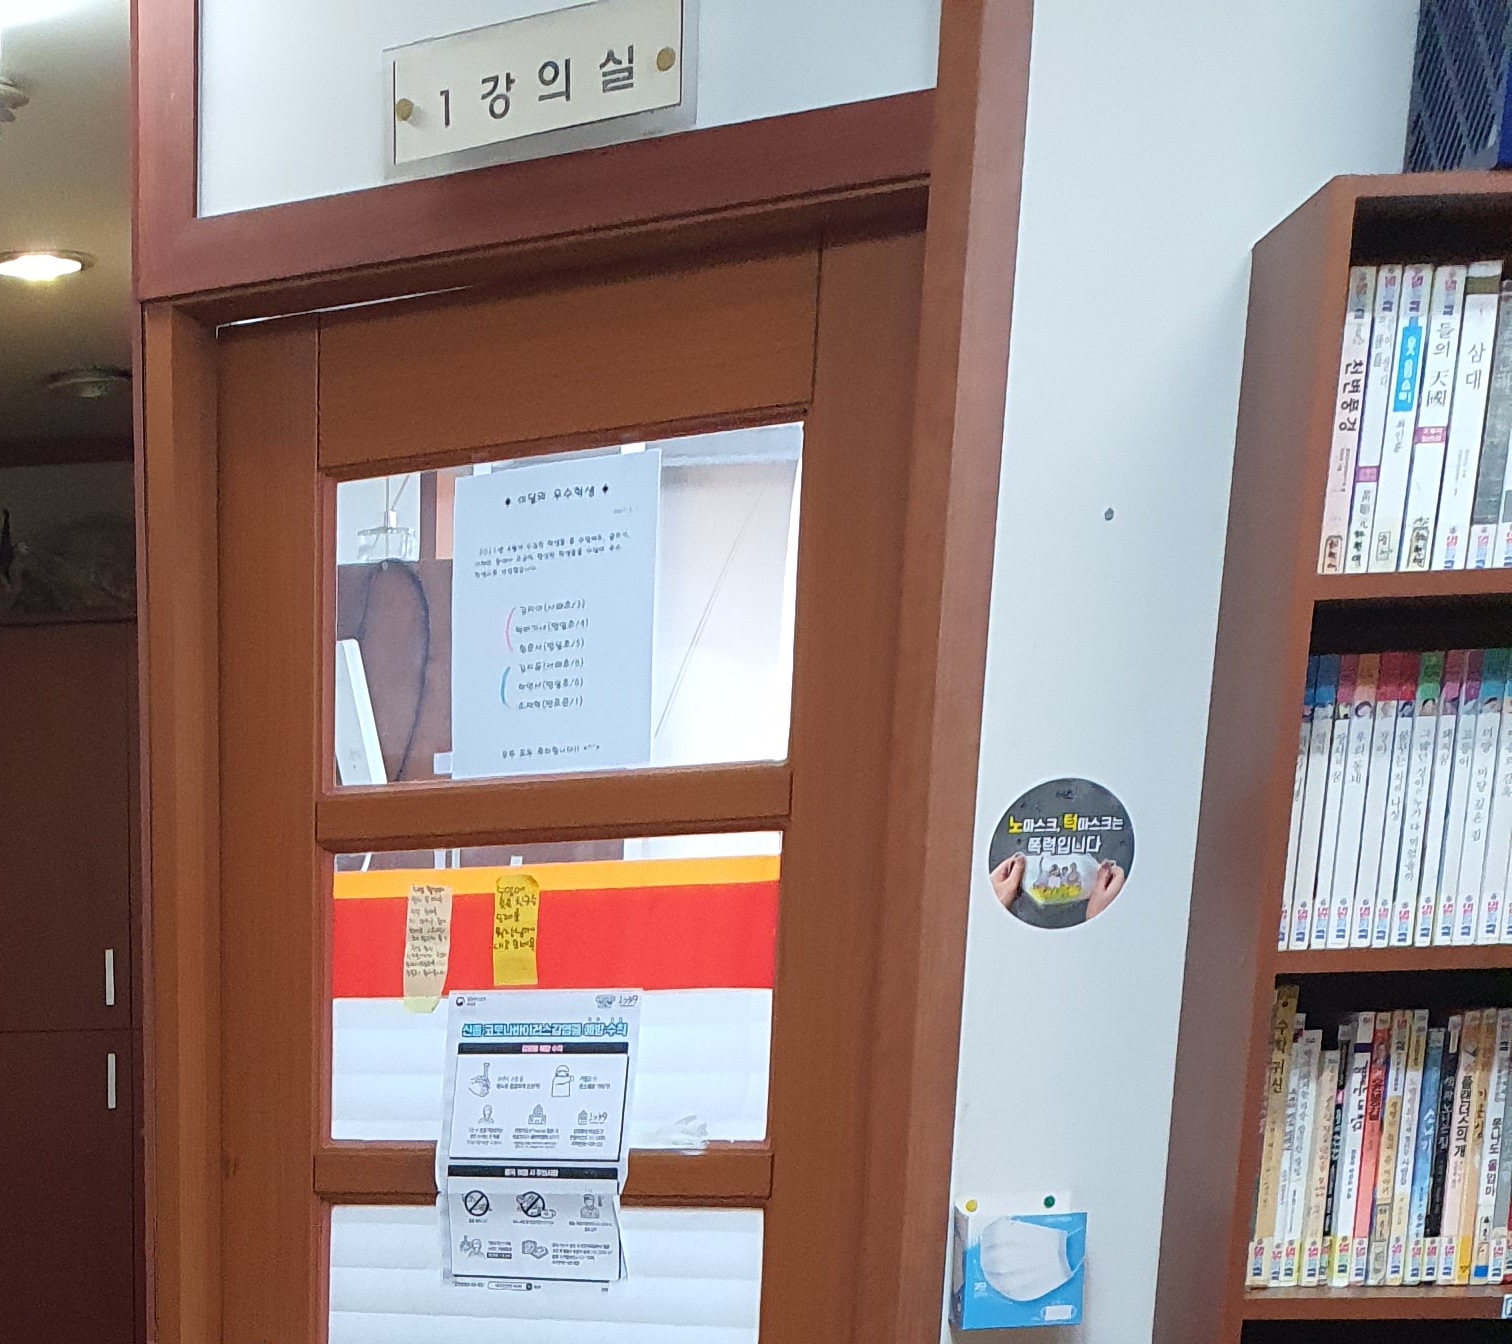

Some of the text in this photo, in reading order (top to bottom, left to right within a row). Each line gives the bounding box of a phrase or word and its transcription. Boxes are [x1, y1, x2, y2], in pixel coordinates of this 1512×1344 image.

[1465, 342, 1486, 391] 삼대
[1338, 358, 1364, 432] 천변풍경
[1062, 812, 1124, 833] 턱마스크는
[1026, 834, 1102, 856] 폭력입니다
